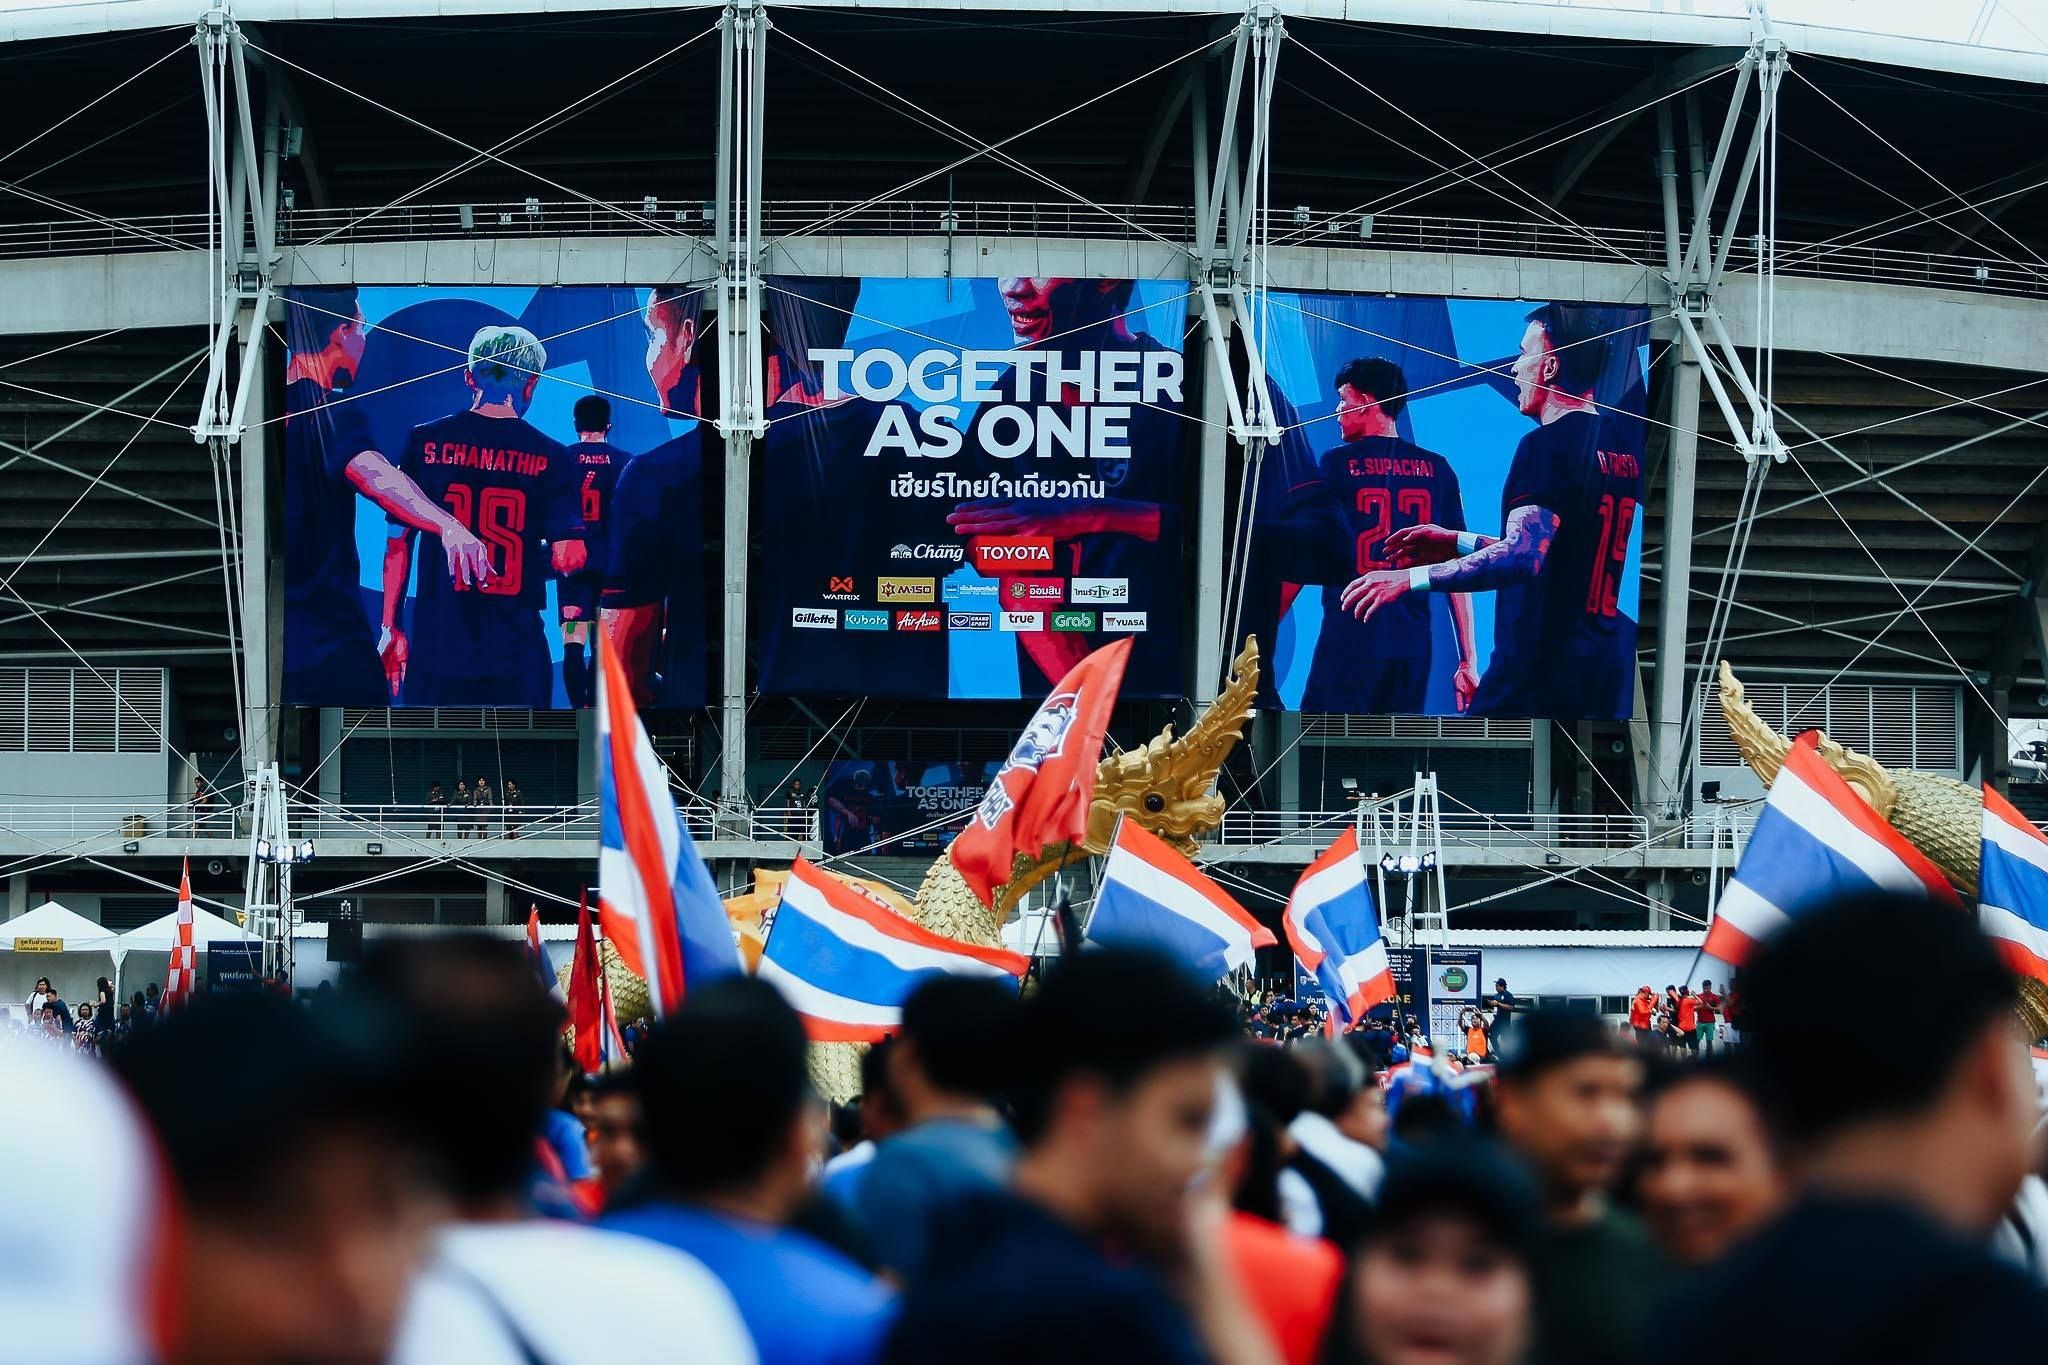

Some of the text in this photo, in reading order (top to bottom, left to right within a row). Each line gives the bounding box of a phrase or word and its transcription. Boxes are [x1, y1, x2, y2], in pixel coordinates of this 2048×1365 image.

[807, 348, 1184, 403] TOGETHER
[863, 405, 1131, 458] AS ONE
[424, 442, 548, 477] S.CHANATHIP
[579, 454, 611, 465] PANSA
[1349, 459, 1434, 478] C.SUPACHAI
[890, 472, 1105, 499] เชียร์ไทยใจเดียวกัน
[444, 483, 527, 596] 18
[914, 544, 964, 561] Chang
[980, 546, 1050, 560] TOYOTA
[822, 593, 860, 601] WARRIX
[1112, 588, 1127, 597] 32
[795, 613, 835, 625] Gillette
[845, 614, 888, 625] Kubota
[1009, 613, 1034, 624] true
[1055, 612, 1091, 627] Grab
[905, 786, 985, 798] TOGETHER
[917, 798, 938, 810] AS
